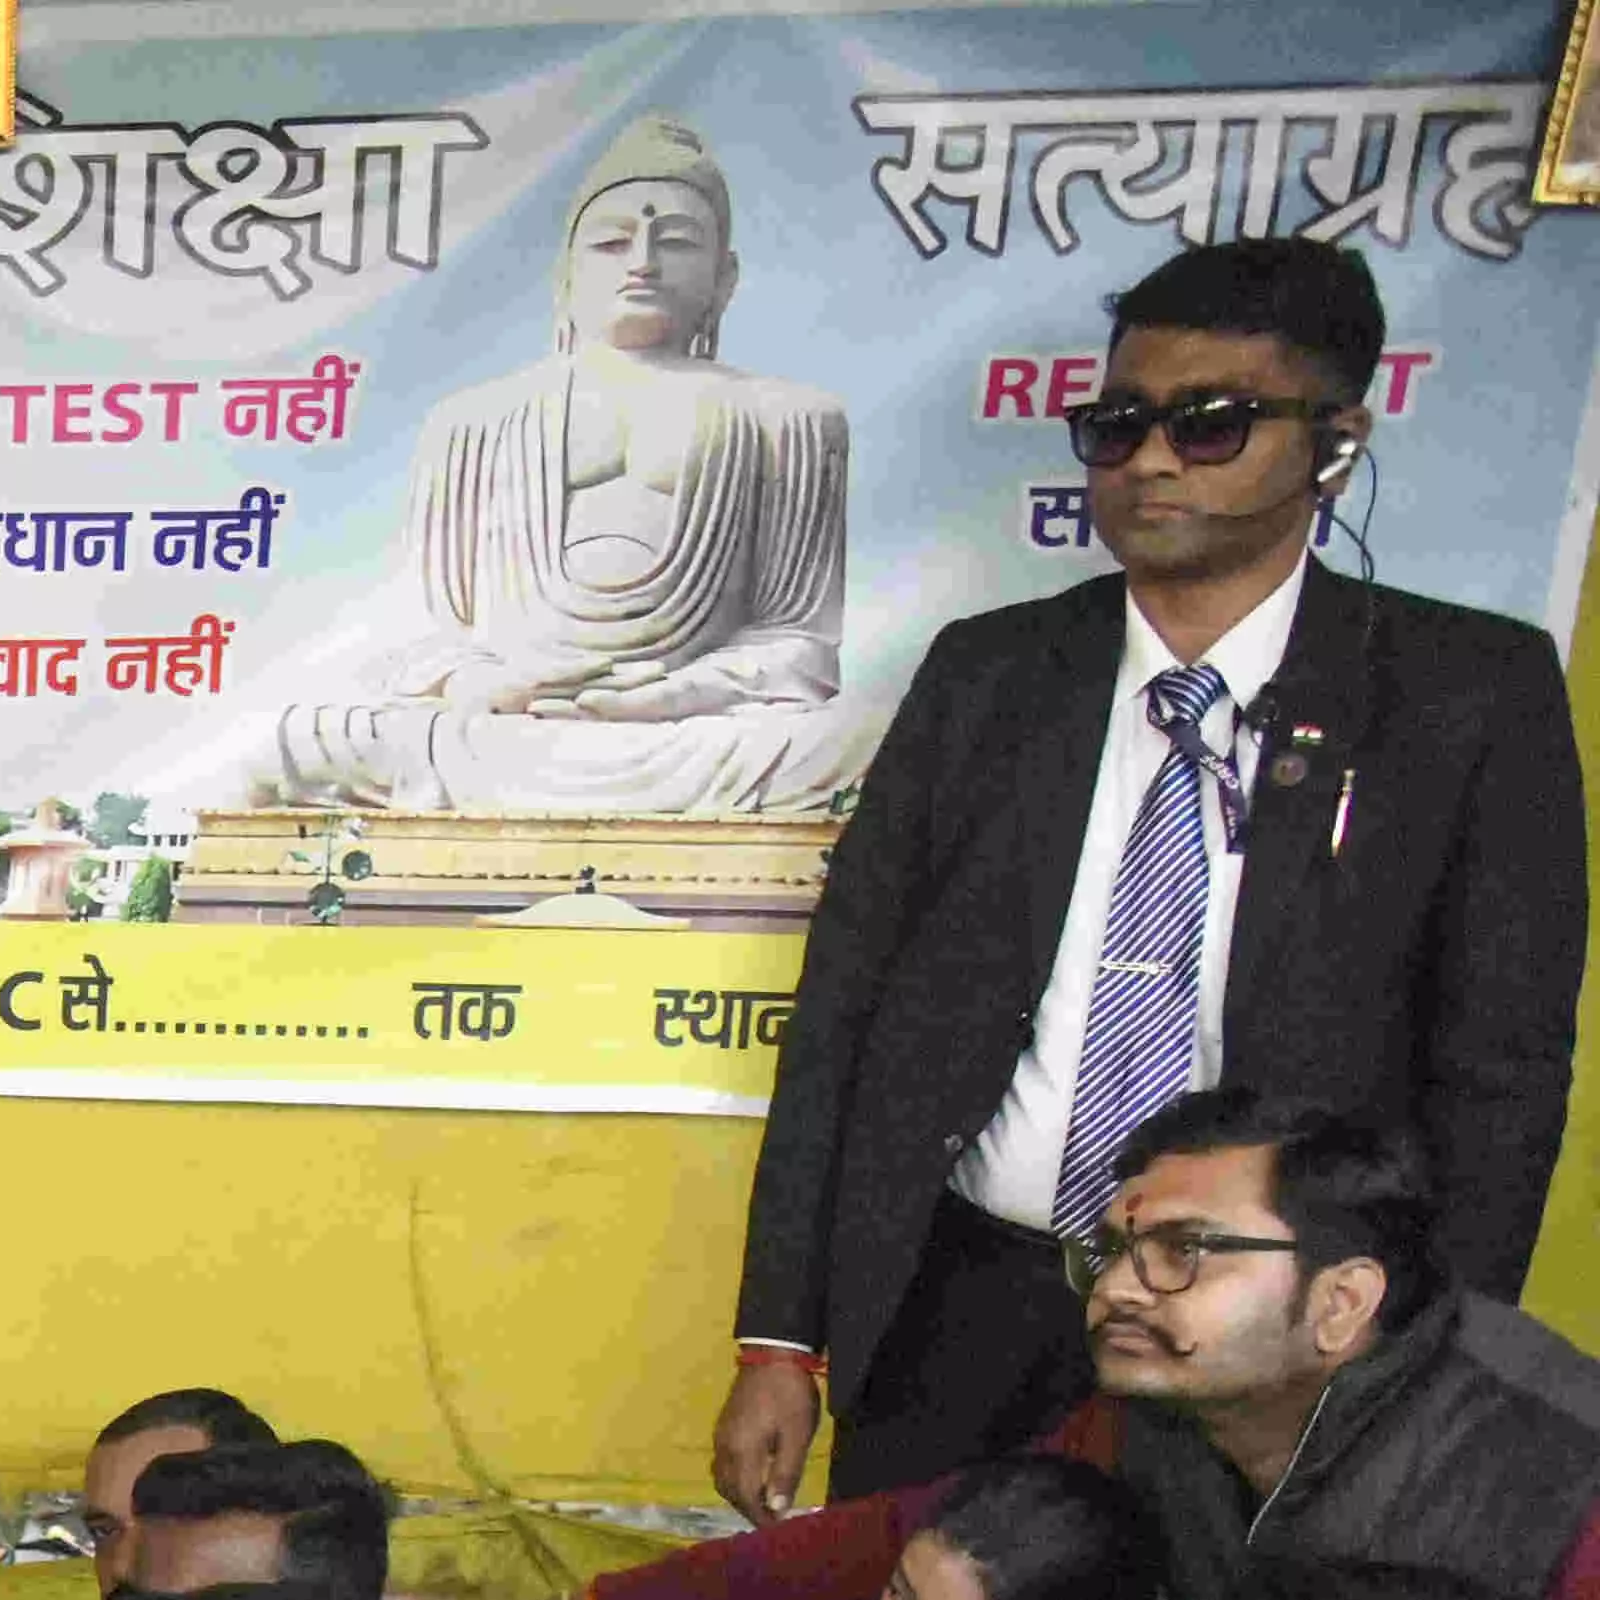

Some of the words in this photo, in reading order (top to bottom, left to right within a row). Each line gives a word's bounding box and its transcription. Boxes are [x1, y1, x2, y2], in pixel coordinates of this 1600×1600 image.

[852, 80, 1542, 260] सत्याग्रह
[222, 354, 362, 441] नहीं
[151, 486, 286, 572] नहीं
[104, 614, 235, 696] नहीं
[412, 980, 522, 1042] तक
